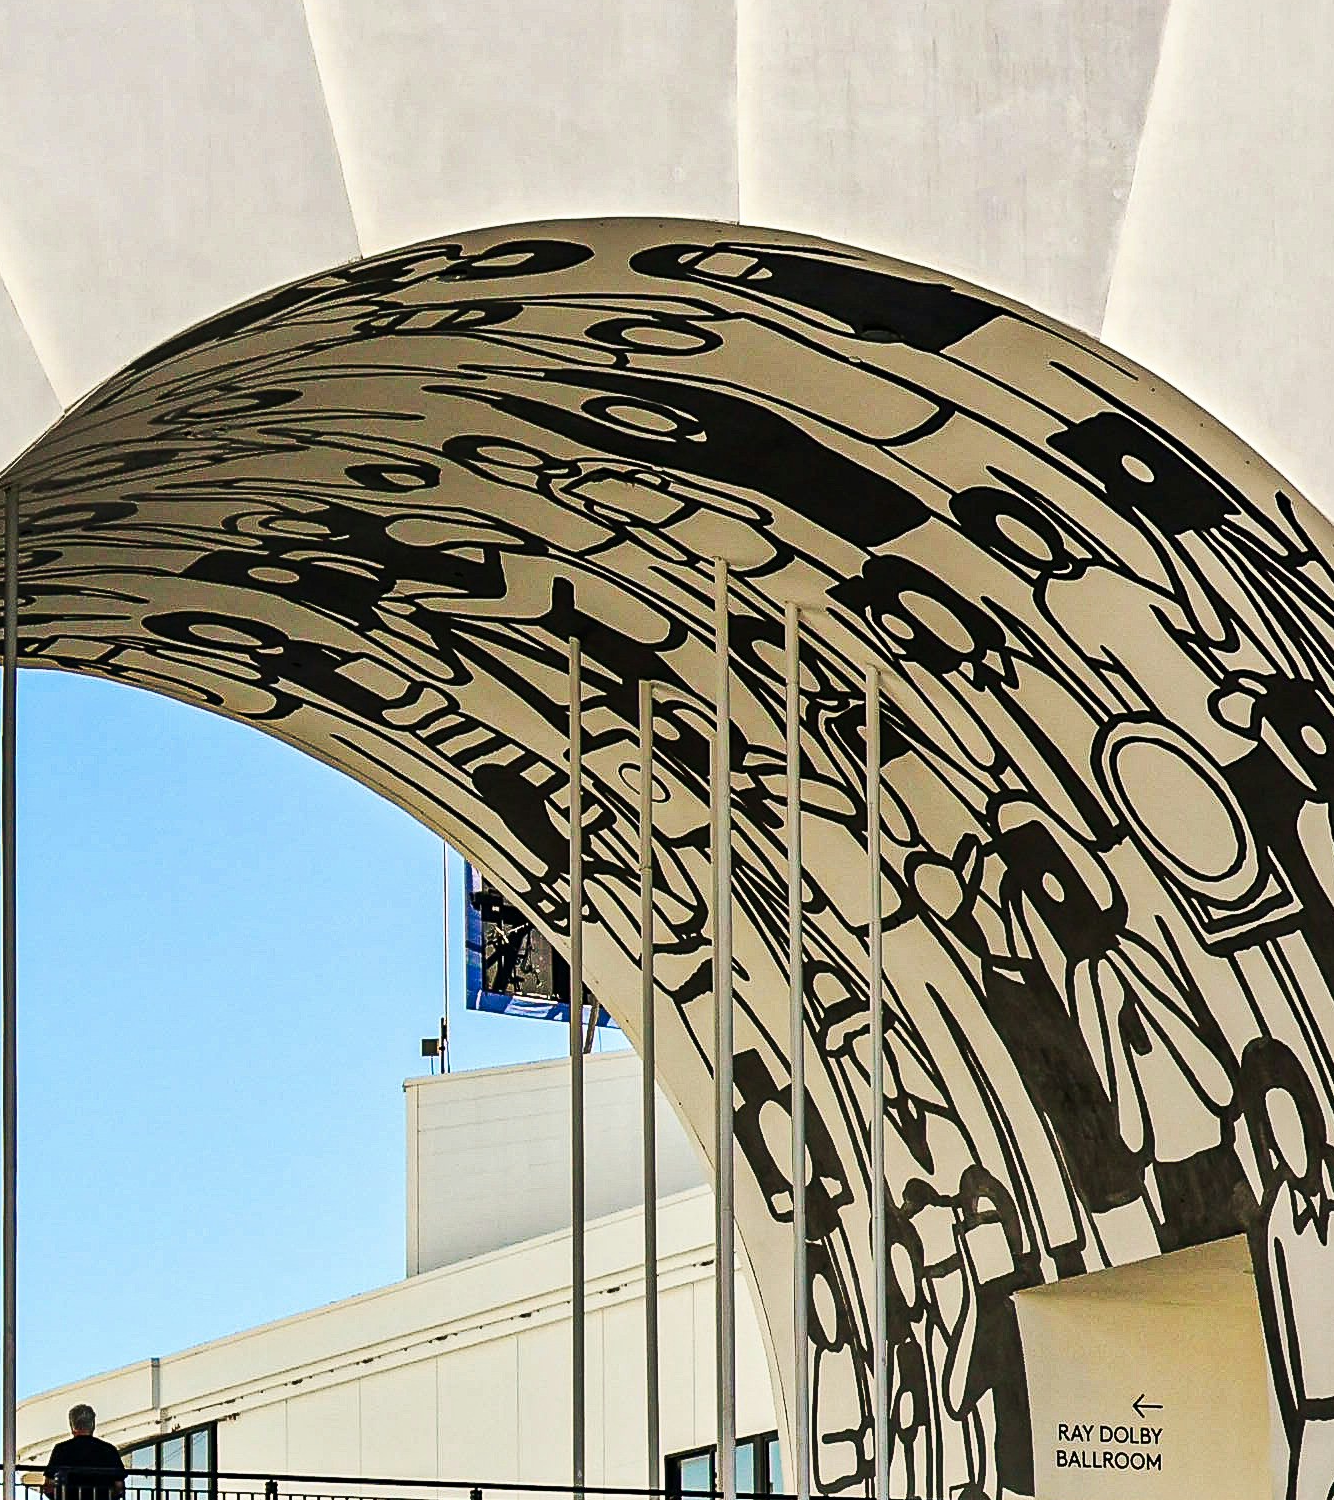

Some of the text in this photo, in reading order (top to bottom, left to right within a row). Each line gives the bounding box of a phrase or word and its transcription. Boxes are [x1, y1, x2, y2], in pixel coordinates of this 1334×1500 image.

[1059, 1424, 1163, 1444] RAY DOLBY
[1056, 1450, 1161, 1471] BALLROOM
